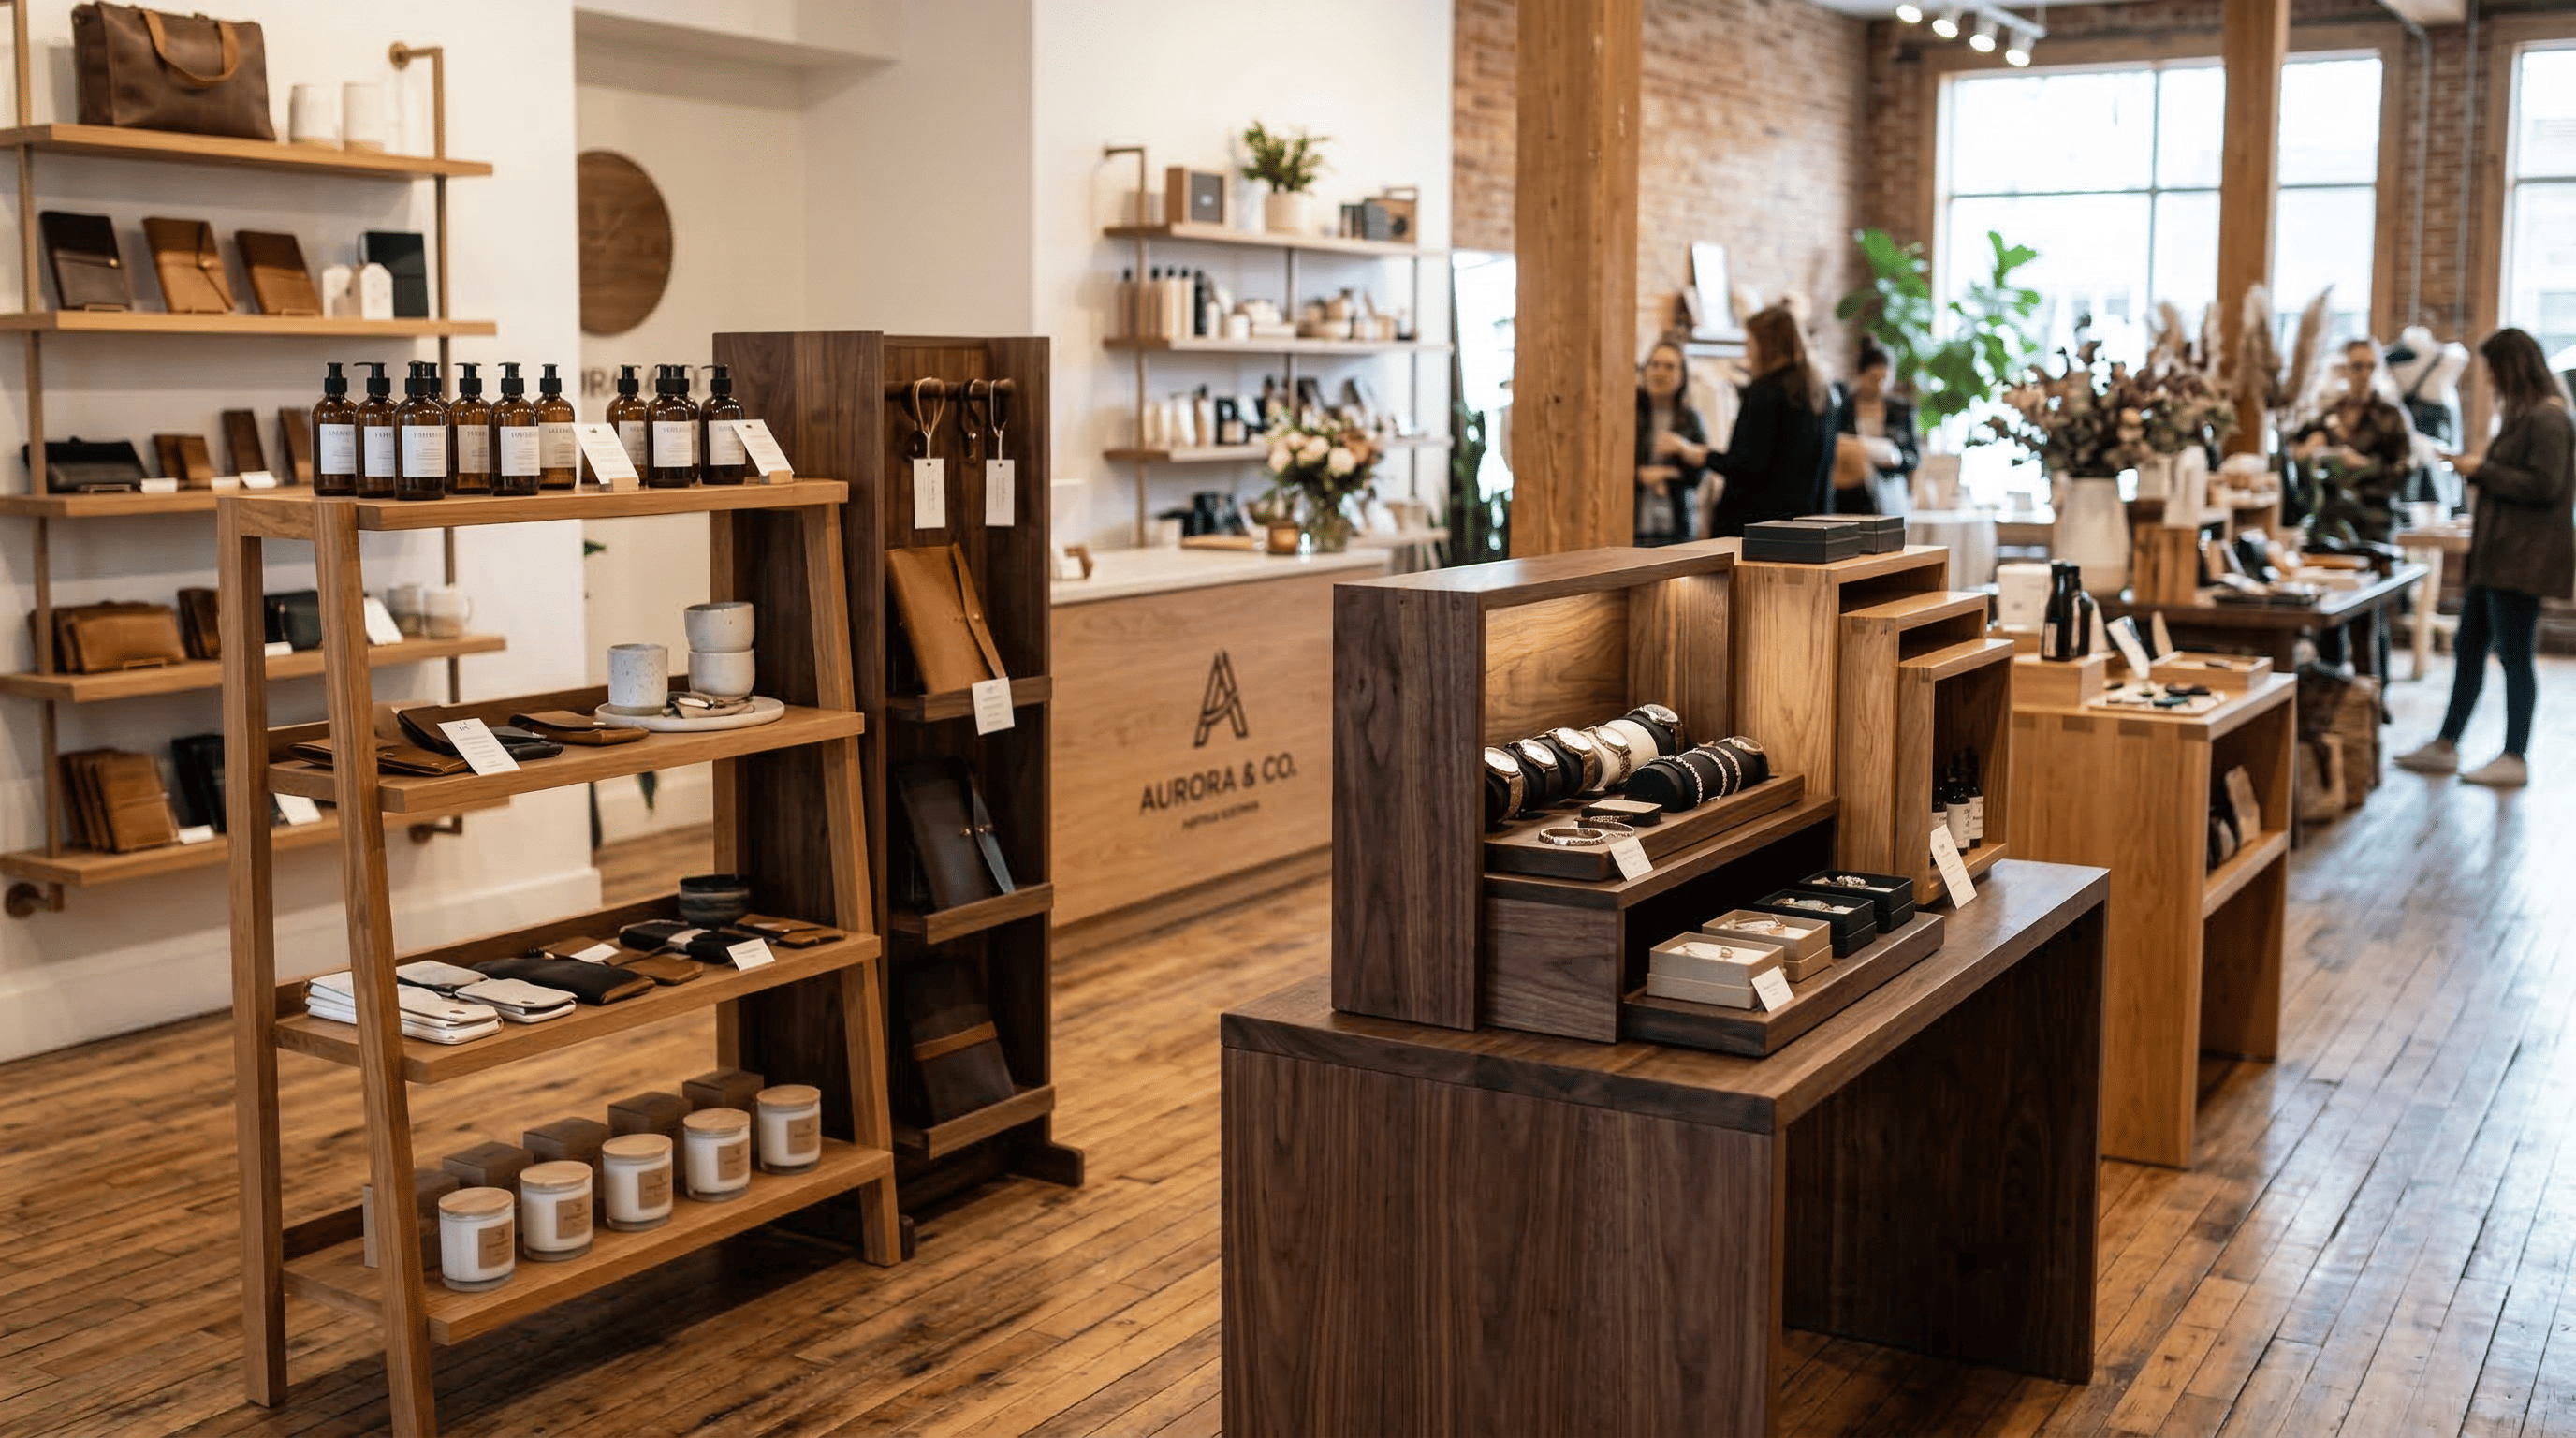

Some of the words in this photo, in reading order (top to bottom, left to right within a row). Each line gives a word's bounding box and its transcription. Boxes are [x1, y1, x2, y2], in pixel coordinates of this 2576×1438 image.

[1139, 765, 1237, 815] AURORA
[1242, 760, 1256, 788] &
[1262, 751, 1298, 784] CO.
